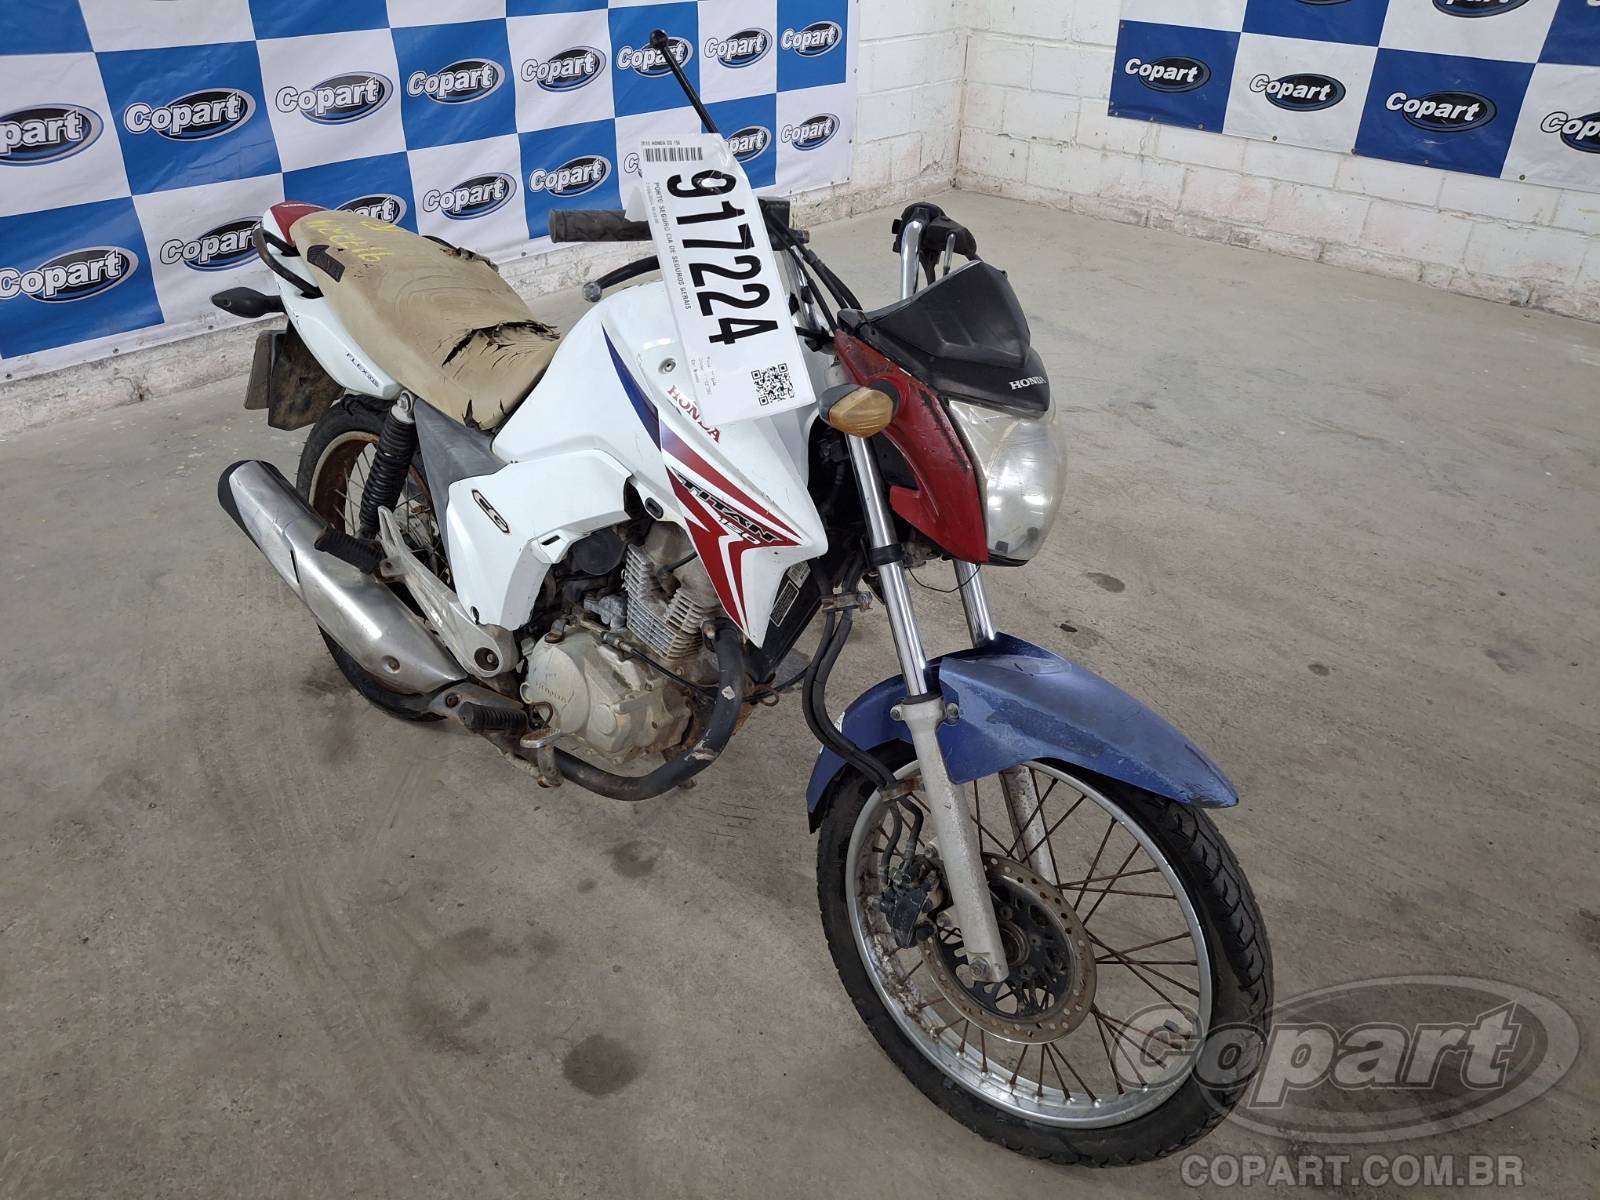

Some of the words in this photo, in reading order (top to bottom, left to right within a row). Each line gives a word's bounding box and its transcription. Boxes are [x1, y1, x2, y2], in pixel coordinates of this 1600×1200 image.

[703, 29, 768, 59] Copart
[780, 22, 837, 50] Copart
[408, 62, 495, 98] Copart
[520, 50, 597, 83] Copart
[1124, 57, 1198, 84] Copart
[276, 76, 380, 116] Copart
[1249, 74, 1333, 103] Copart
[124, 92, 242, 136] Copart
[1386, 92, 1482, 122] Copart
[0, 109, 83, 155] part
[729, 129, 766, 154] part
[781, 117, 833, 145] Copart
[1540, 111, 1600, 141] Cop
[529, 159, 602, 194] Copart
[423, 175, 507, 213] Copart
[0, 248, 122, 299] Copart
[659, 205, 671, 231] SEGURO
[672, 255, 685, 286] SEGUROS
[680, 287, 691, 310] GERAIS
[667, 169, 779, 345] 917224
[1008, 376, 1047, 390] HONDA
[679, 472, 784, 543] TITAN
